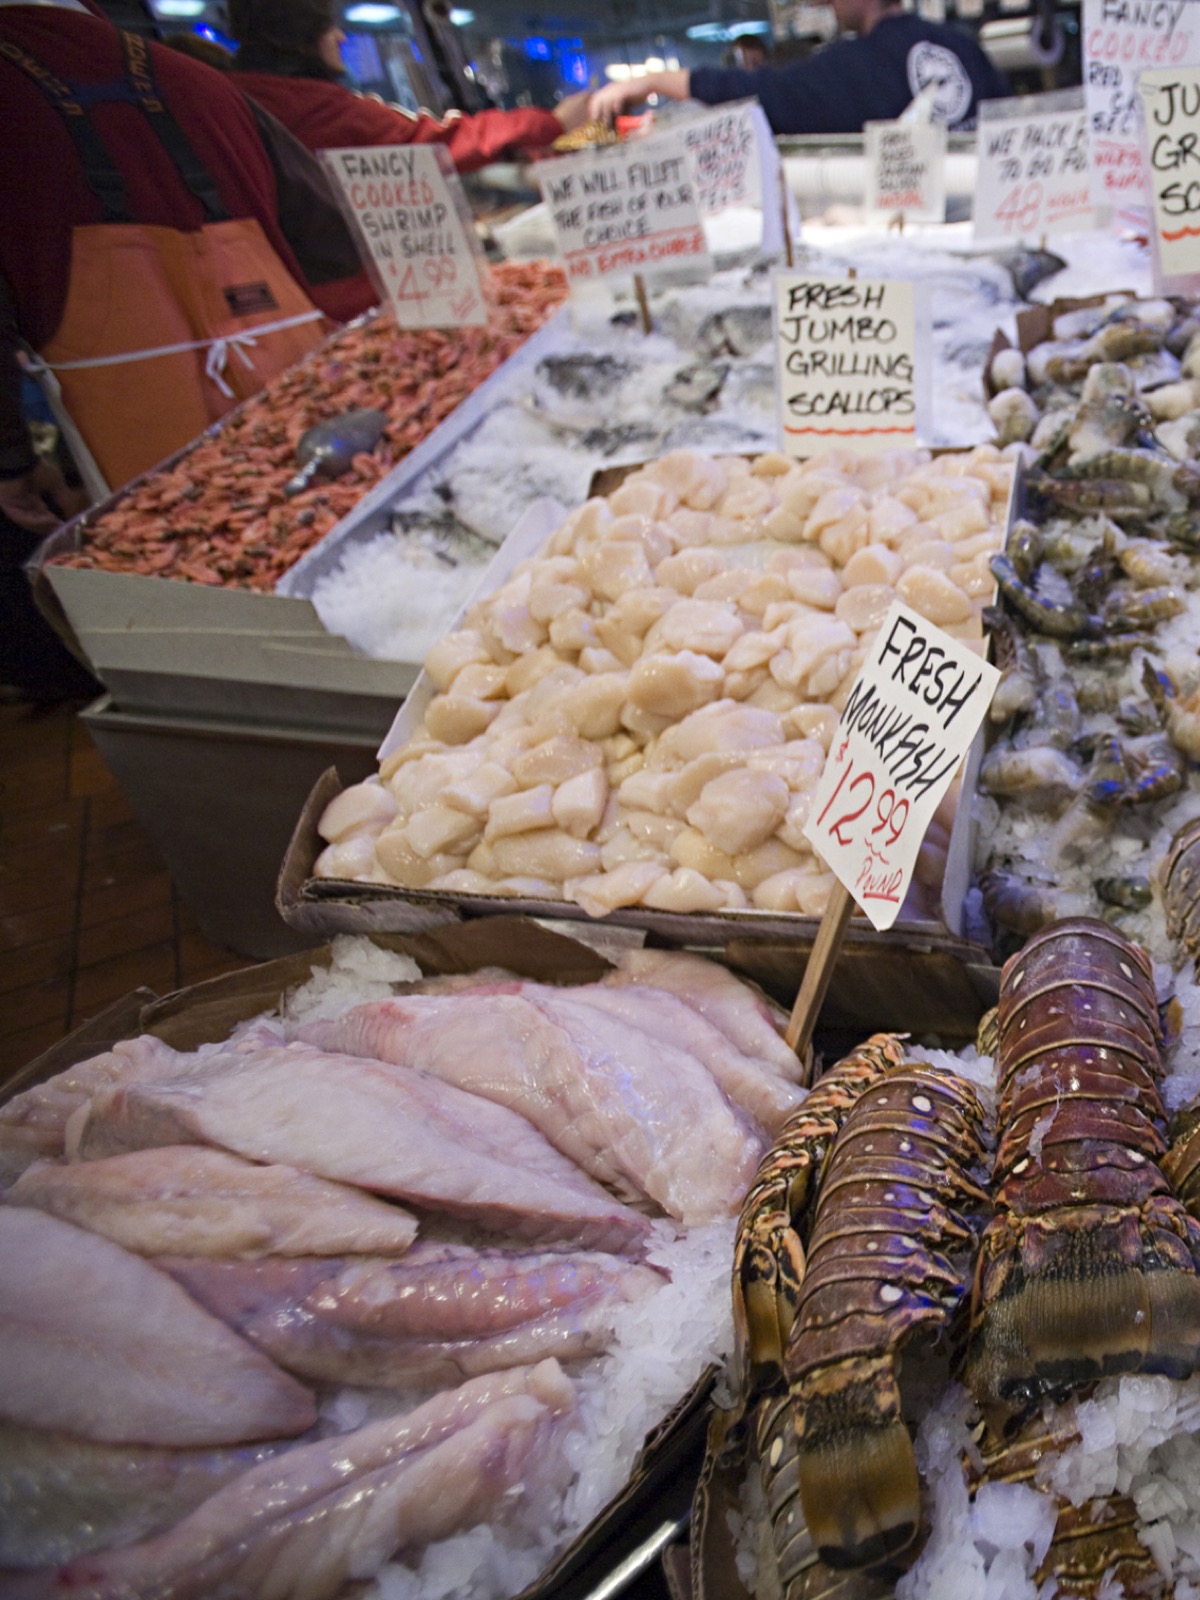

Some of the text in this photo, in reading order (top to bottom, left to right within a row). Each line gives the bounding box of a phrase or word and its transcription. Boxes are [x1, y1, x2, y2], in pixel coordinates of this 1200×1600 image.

[1103, 0, 1186, 42] FANCY
[1088, 29, 1189, 64] COOKED
[988, 126, 1017, 157] WE
[341, 147, 415, 181] FANCY
[549, 173, 574, 204] WE
[580, 167, 625, 196] WILL
[627, 156, 685, 189] FILLET
[998, 156, 1024, 182] TO
[352, 176, 434, 209] COOKED
[555, 203, 582, 231] THE
[587, 197, 624, 222] FISH
[628, 193, 648, 213] OF
[655, 183, 694, 210] YOUR
[361, 202, 447, 238] SHRIMP
[583, 215, 650, 249] CHOICE
[374, 232, 455, 260] IN SHELL
[568, 232, 707, 279] NO EXTRA CHARGE
[788, 283, 885, 311] FRESH
[779, 315, 897, 344] JUMBO
[786, 349, 914, 384] GRILLING
[787, 387, 916, 416] SCALLOPS
[878, 615, 982, 730] FRESH
[840, 678, 960, 803] MONKFISH
[855, 857, 904, 895] POUND
